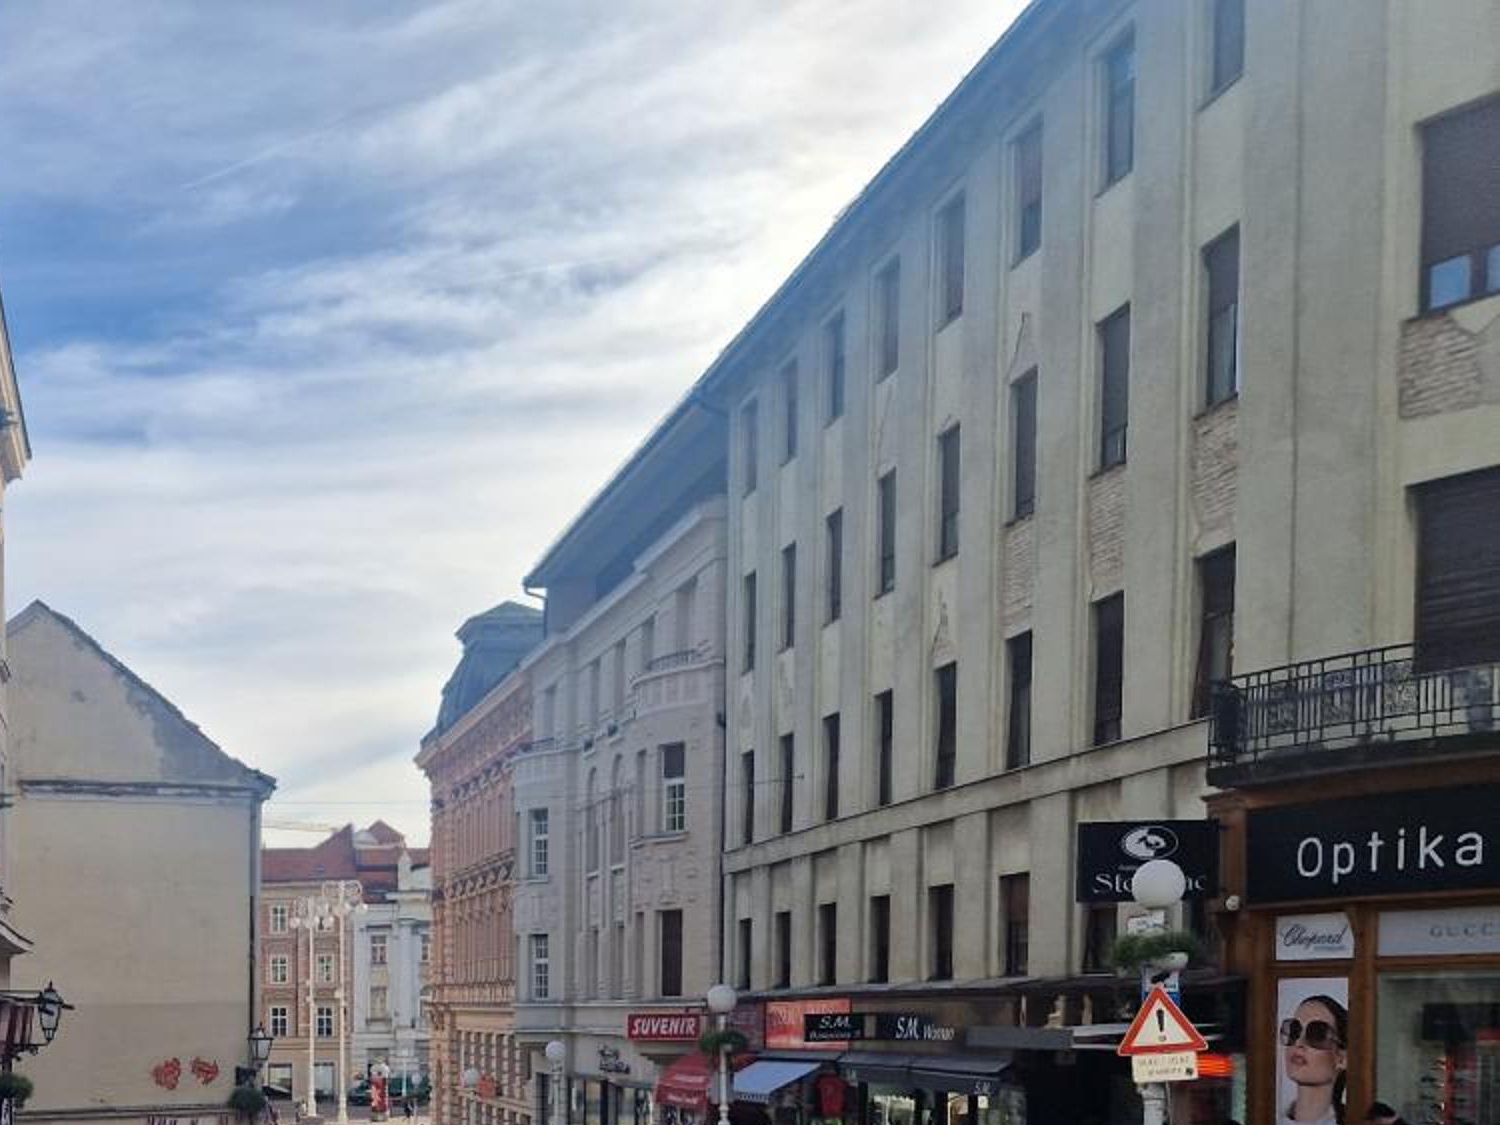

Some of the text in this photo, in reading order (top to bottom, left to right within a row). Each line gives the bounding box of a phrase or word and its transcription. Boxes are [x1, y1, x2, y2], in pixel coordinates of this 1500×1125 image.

[1296, 826, 1484, 885] Optika
[1283, 922, 1349, 950] Chopard
[631, 1016, 697, 1037] SUVENIR
